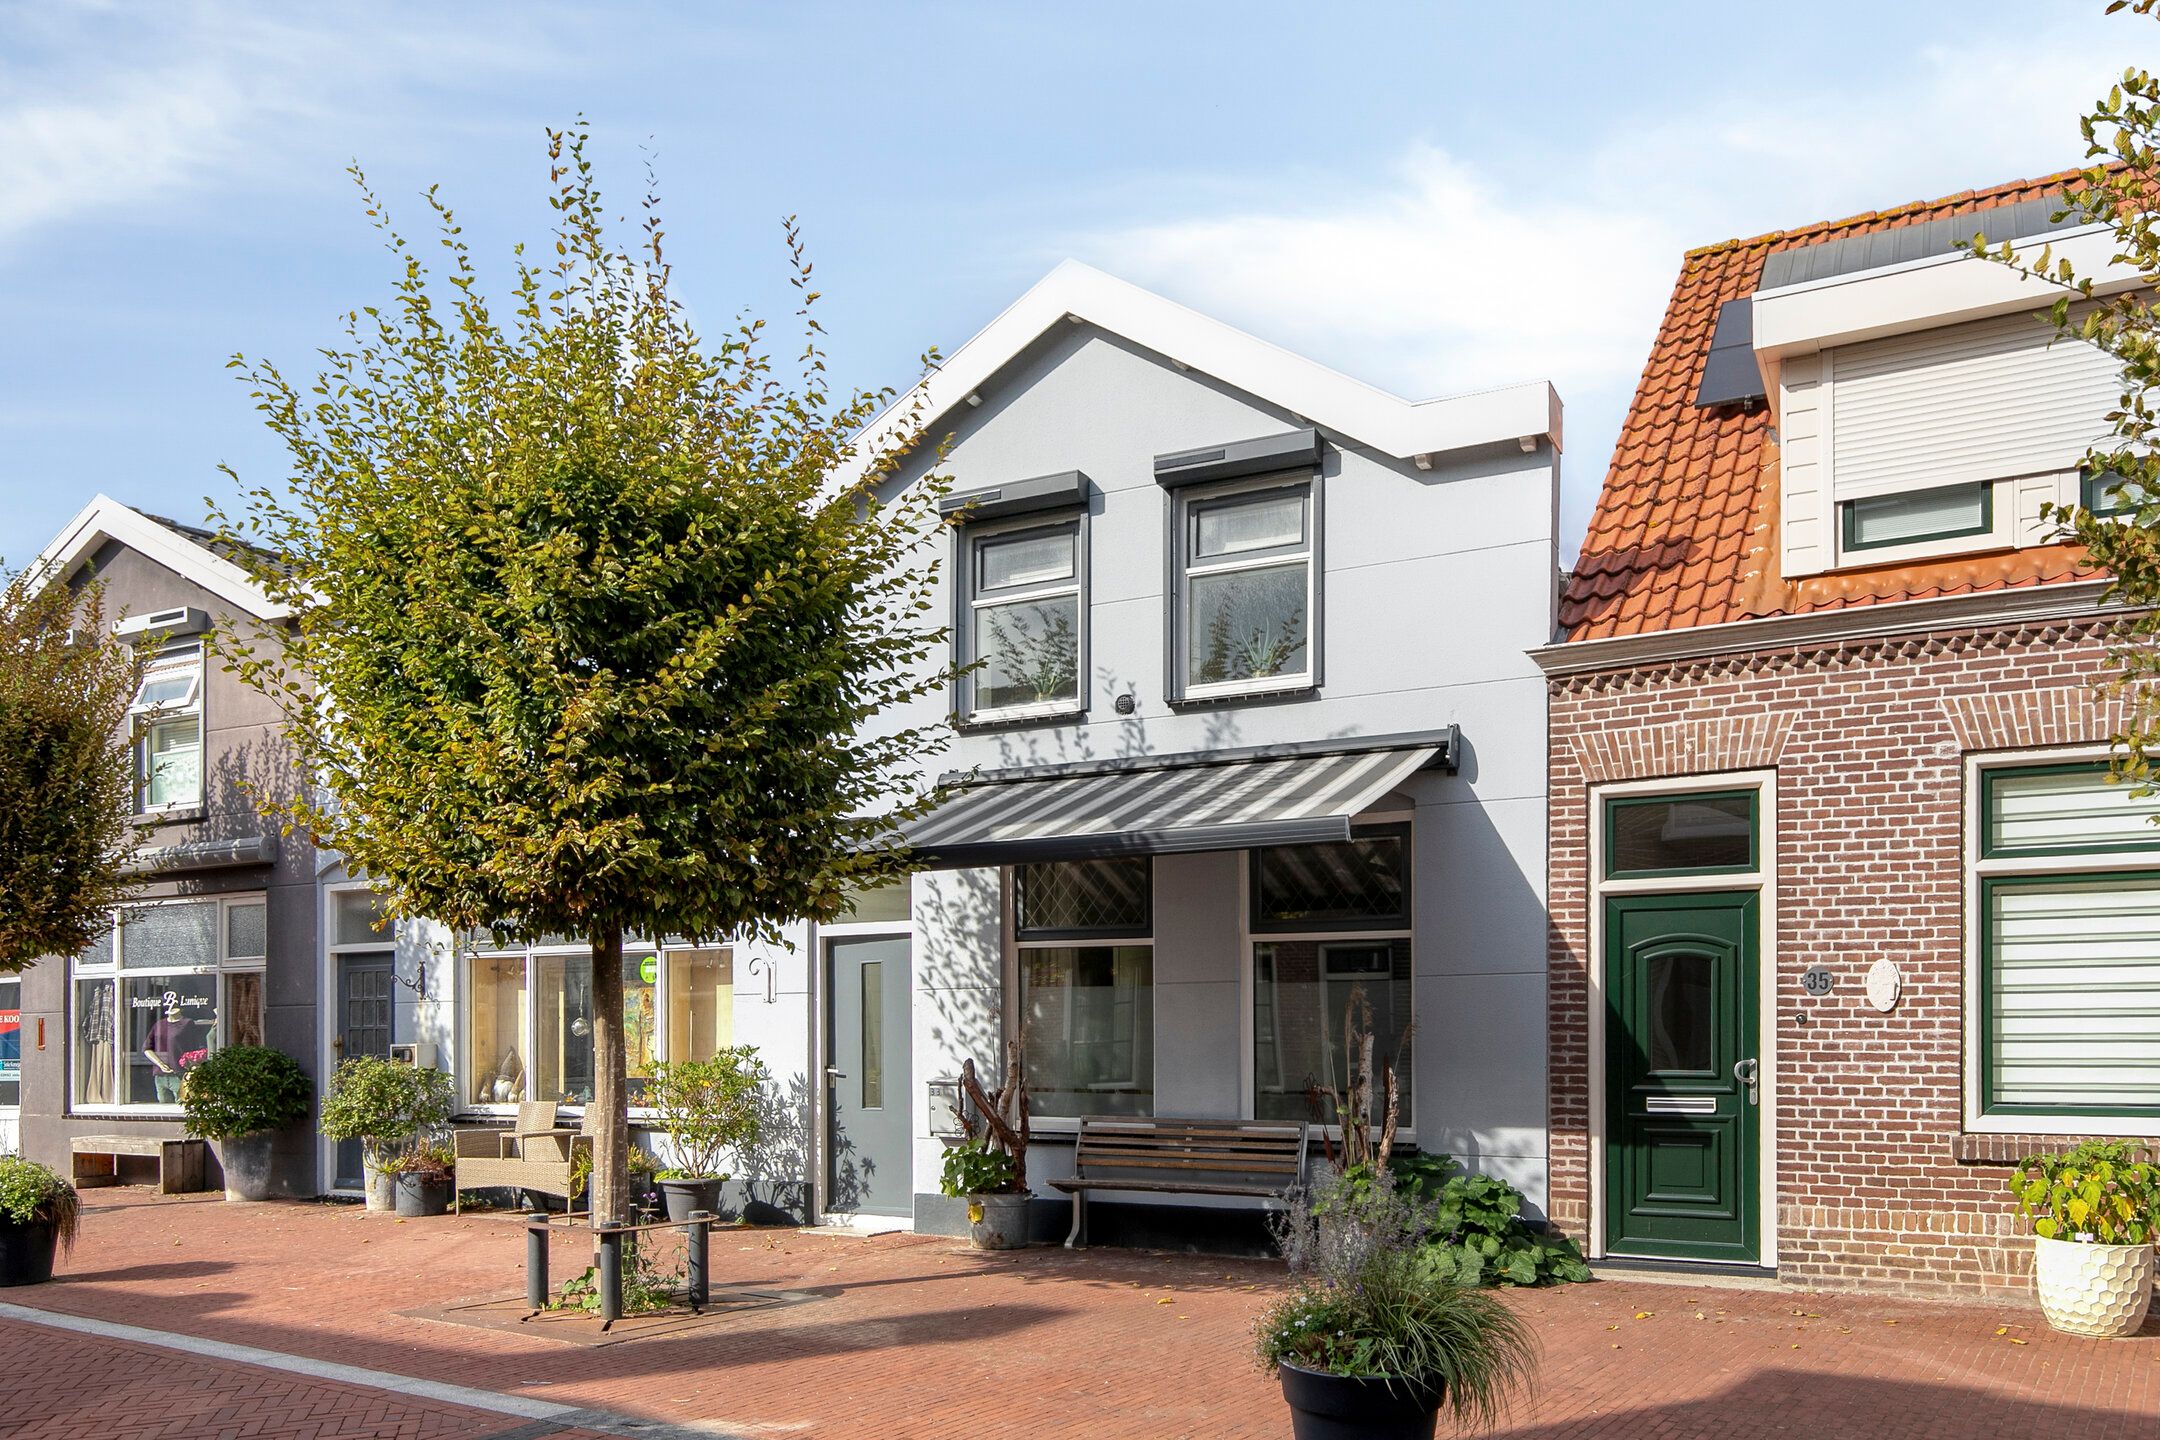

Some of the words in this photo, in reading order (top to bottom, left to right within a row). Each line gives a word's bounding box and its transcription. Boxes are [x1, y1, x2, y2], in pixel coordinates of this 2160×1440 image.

[1808, 972, 1828, 990] 35
[132, 997, 161, 1010] Boutique
[930, 1088, 940, 1096] 33
